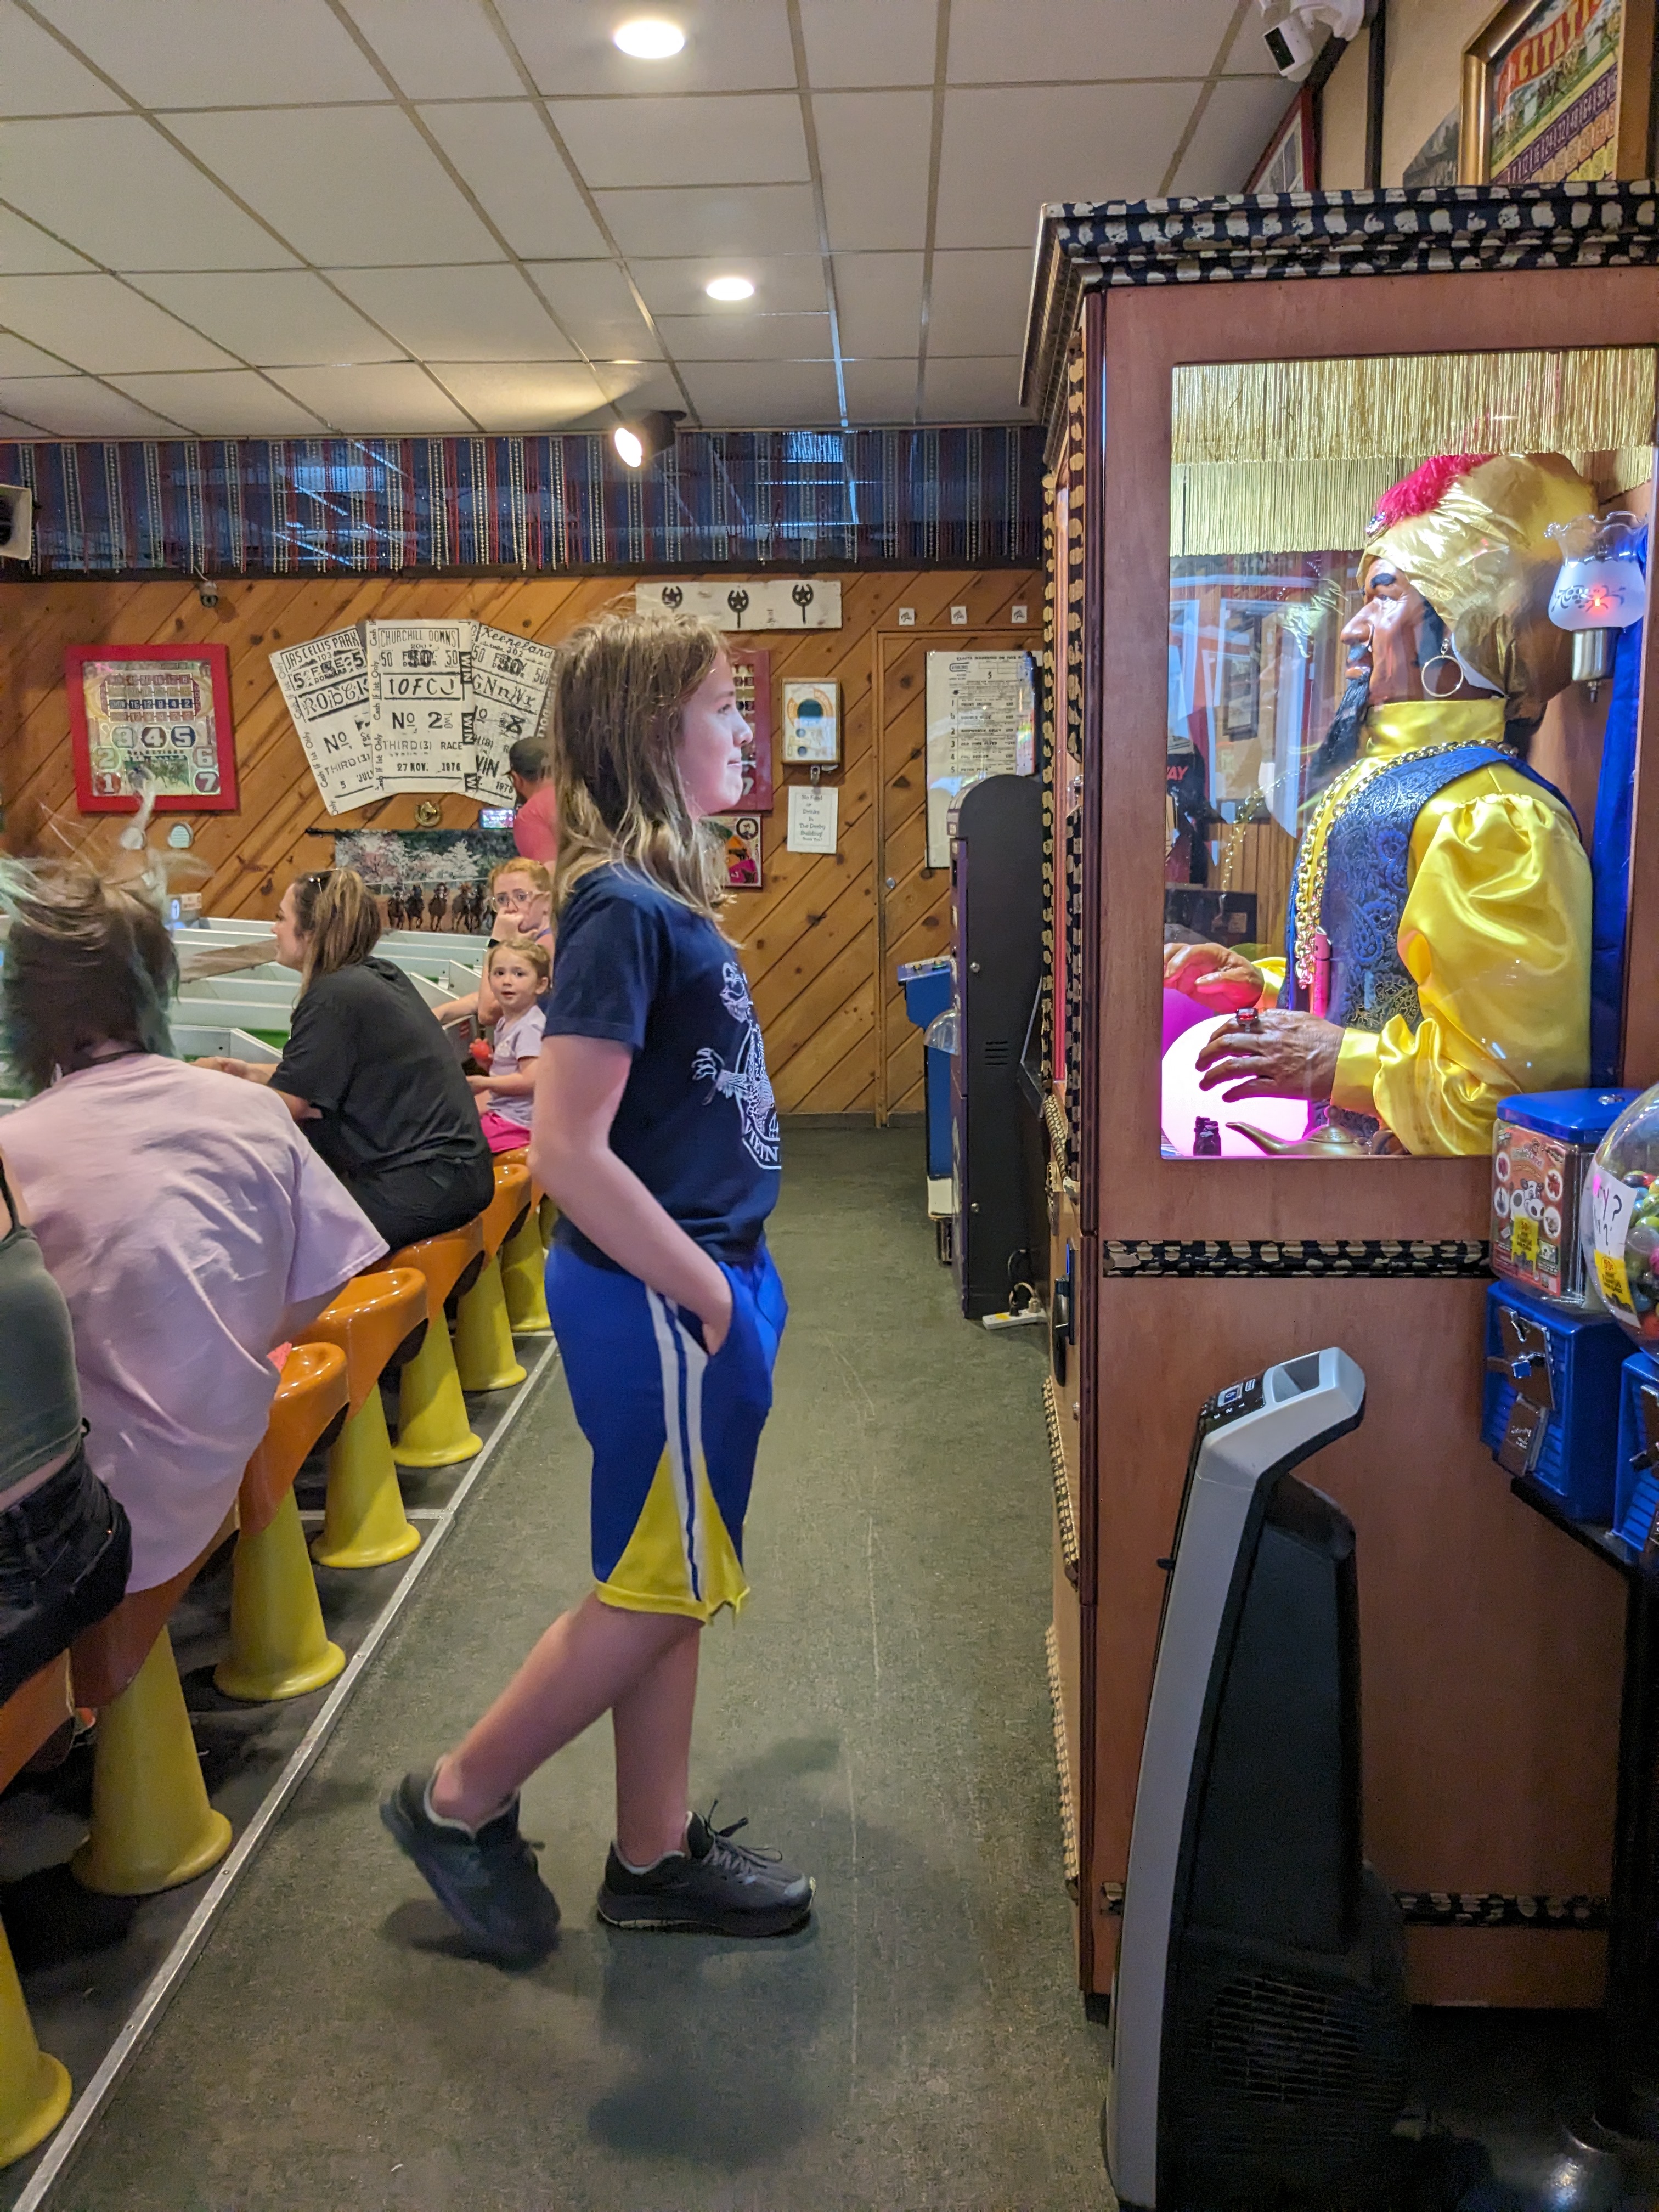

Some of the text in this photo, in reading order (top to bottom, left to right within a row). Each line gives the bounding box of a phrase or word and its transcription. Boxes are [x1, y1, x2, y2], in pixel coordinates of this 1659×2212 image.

[308, 640, 331, 656] ELLIS
[331, 631, 360, 648] PARK
[381, 630, 424, 648] CHURCHILL
[428, 629, 456, 648] DOWNS
[481, 627, 553, 659] Keeneland
[317, 651, 332, 662] 103
[381, 651, 393, 667] 50
[445, 650, 459, 666] 50
[506, 647, 523, 658] 302
[276, 662, 286, 680] Only
[293, 672, 306, 689] 5
[351, 651, 365, 668] 5
[371, 661, 380, 679] Only
[460, 653, 472, 683] WIN
[184, 699, 191, 708] 2
[373, 702, 381, 720] Cash
[427, 711, 443, 729] 2
[463, 715, 475, 743] WIN
[116, 727, 193, 748] 3 4 5
[302, 731, 313, 749] Only
[374, 733, 383, 752] Only
[441, 741, 464, 751] RACE
[97, 748, 116, 768] 2
[196, 748, 214, 767] 6
[397, 763, 408, 772] 27
[410, 763, 429, 772] NOV.
[1166, 766, 1189, 781] AY
[103, 773, 115, 793] 1
[198, 773, 217, 792] 7
[317, 770, 329, 788] Cash
[340, 780, 347, 789] 5
[744, 1116, 781, 1163] VIETN
